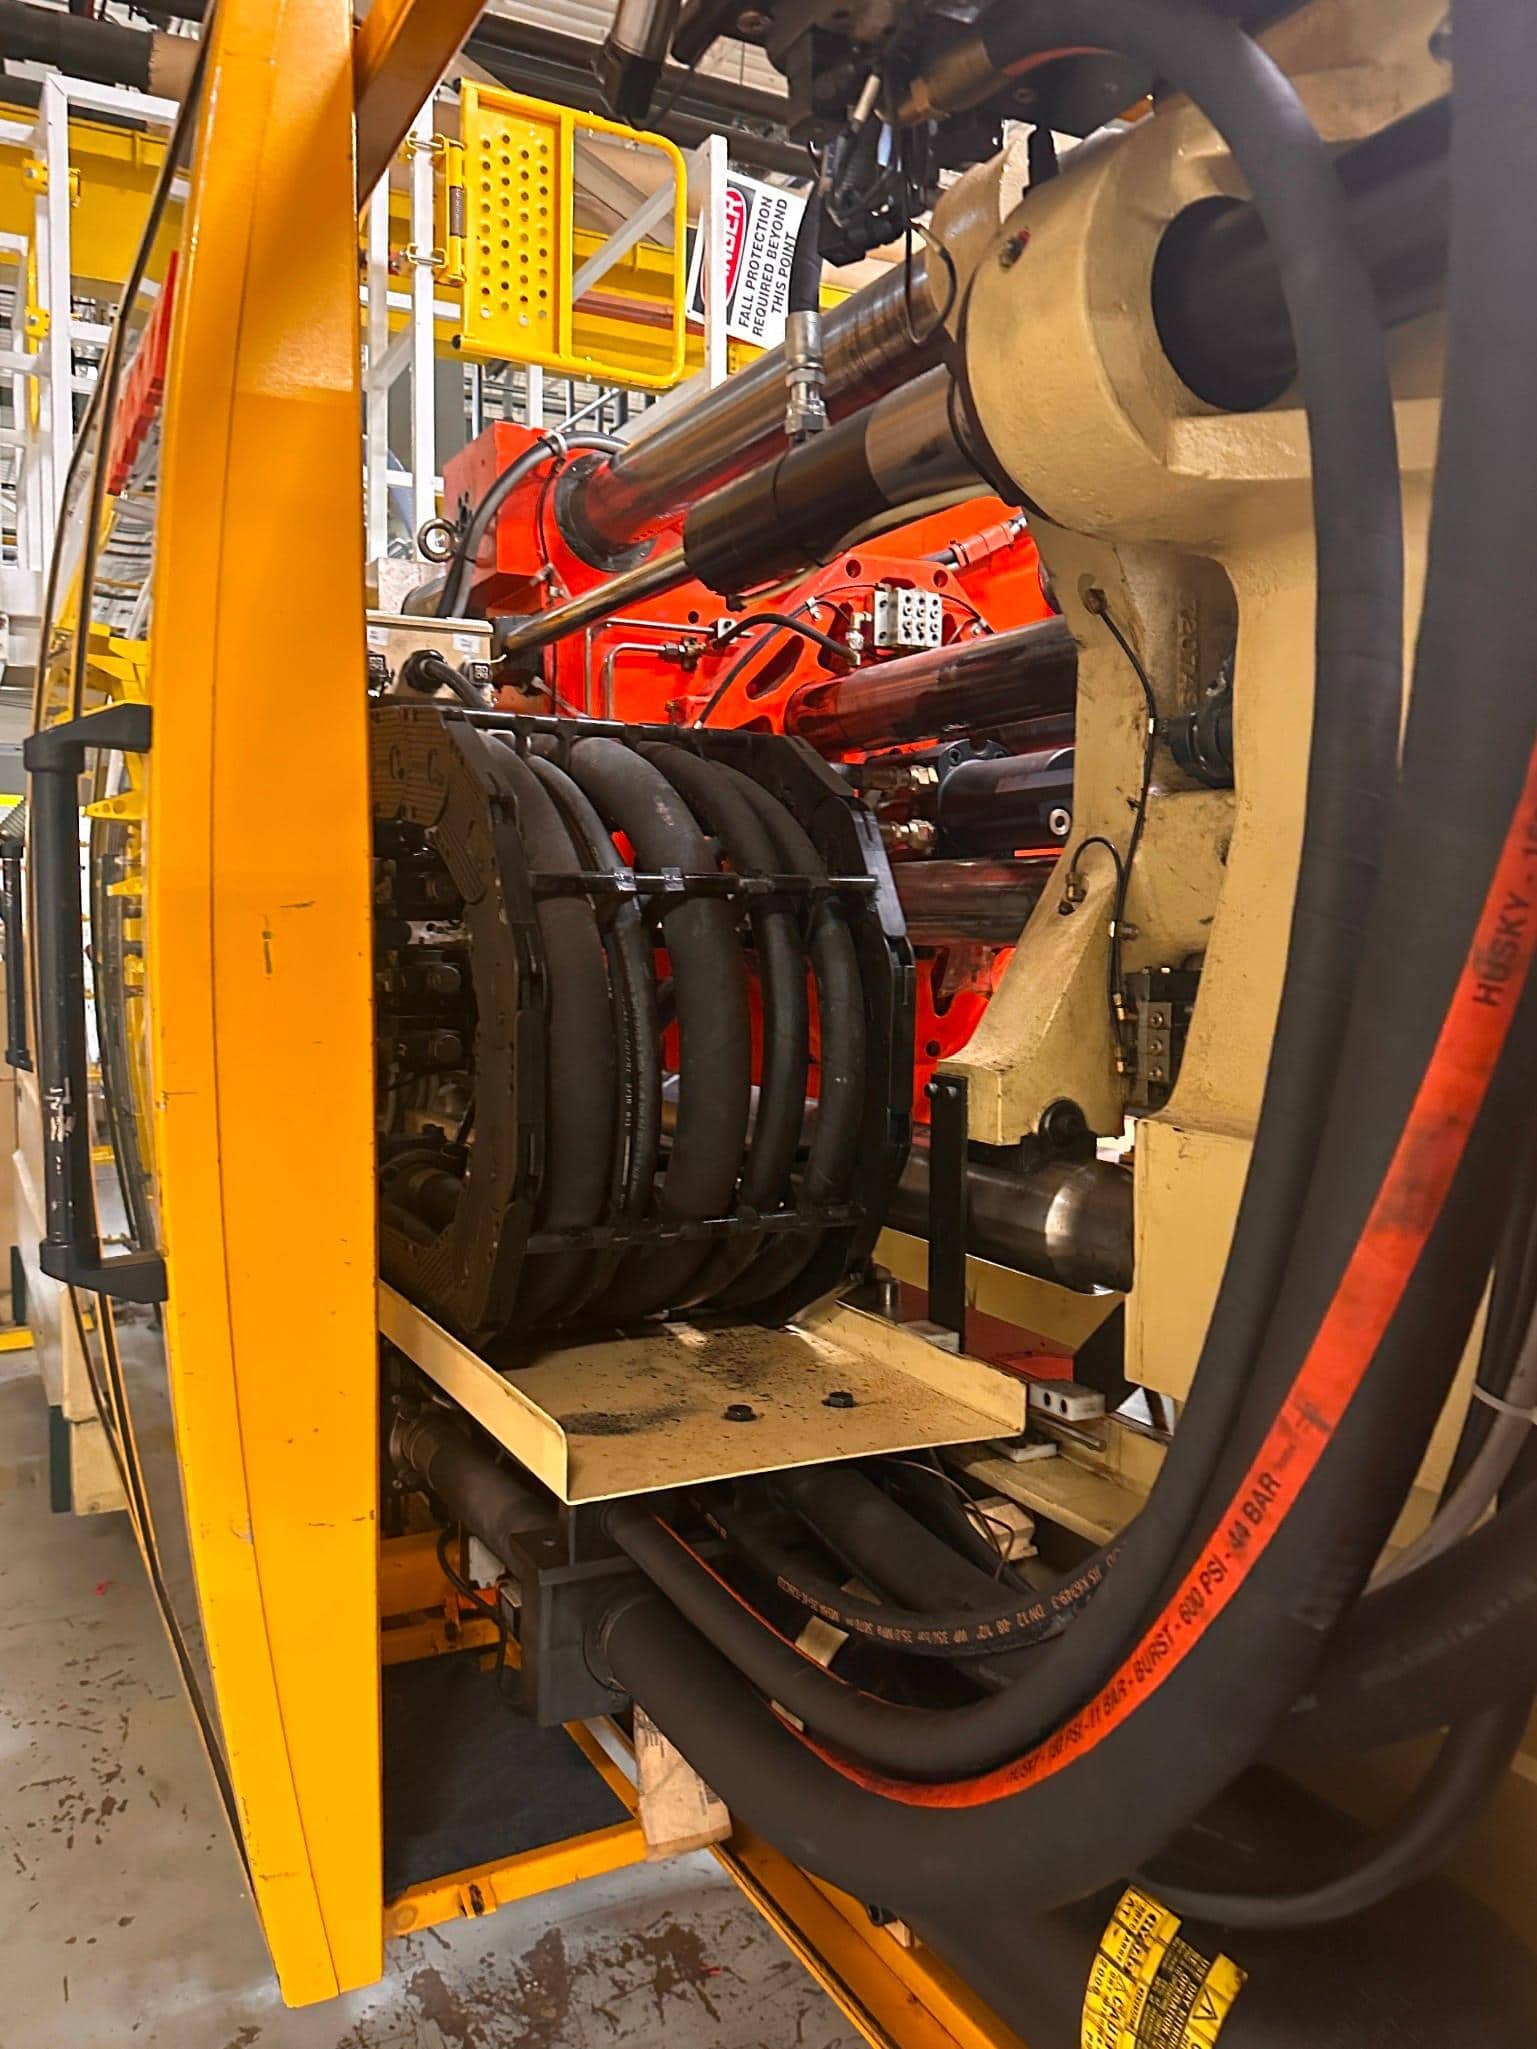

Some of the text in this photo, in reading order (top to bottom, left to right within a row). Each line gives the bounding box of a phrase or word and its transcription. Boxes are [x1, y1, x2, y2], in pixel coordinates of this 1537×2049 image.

[738, 196, 773, 328] FALL PROTECTION
[752, 199, 788, 337] REQUIRED BEYOND
[771, 231, 796, 314] THIS POINT
[1473, 891, 1530, 1006] HUSKY
[1132, 1622, 1175, 1683] BURST
[1178, 1586, 1206, 1625] 600
[1200, 1553, 1229, 1595] PSI
[1242, 1471, 1282, 1527] BAR
